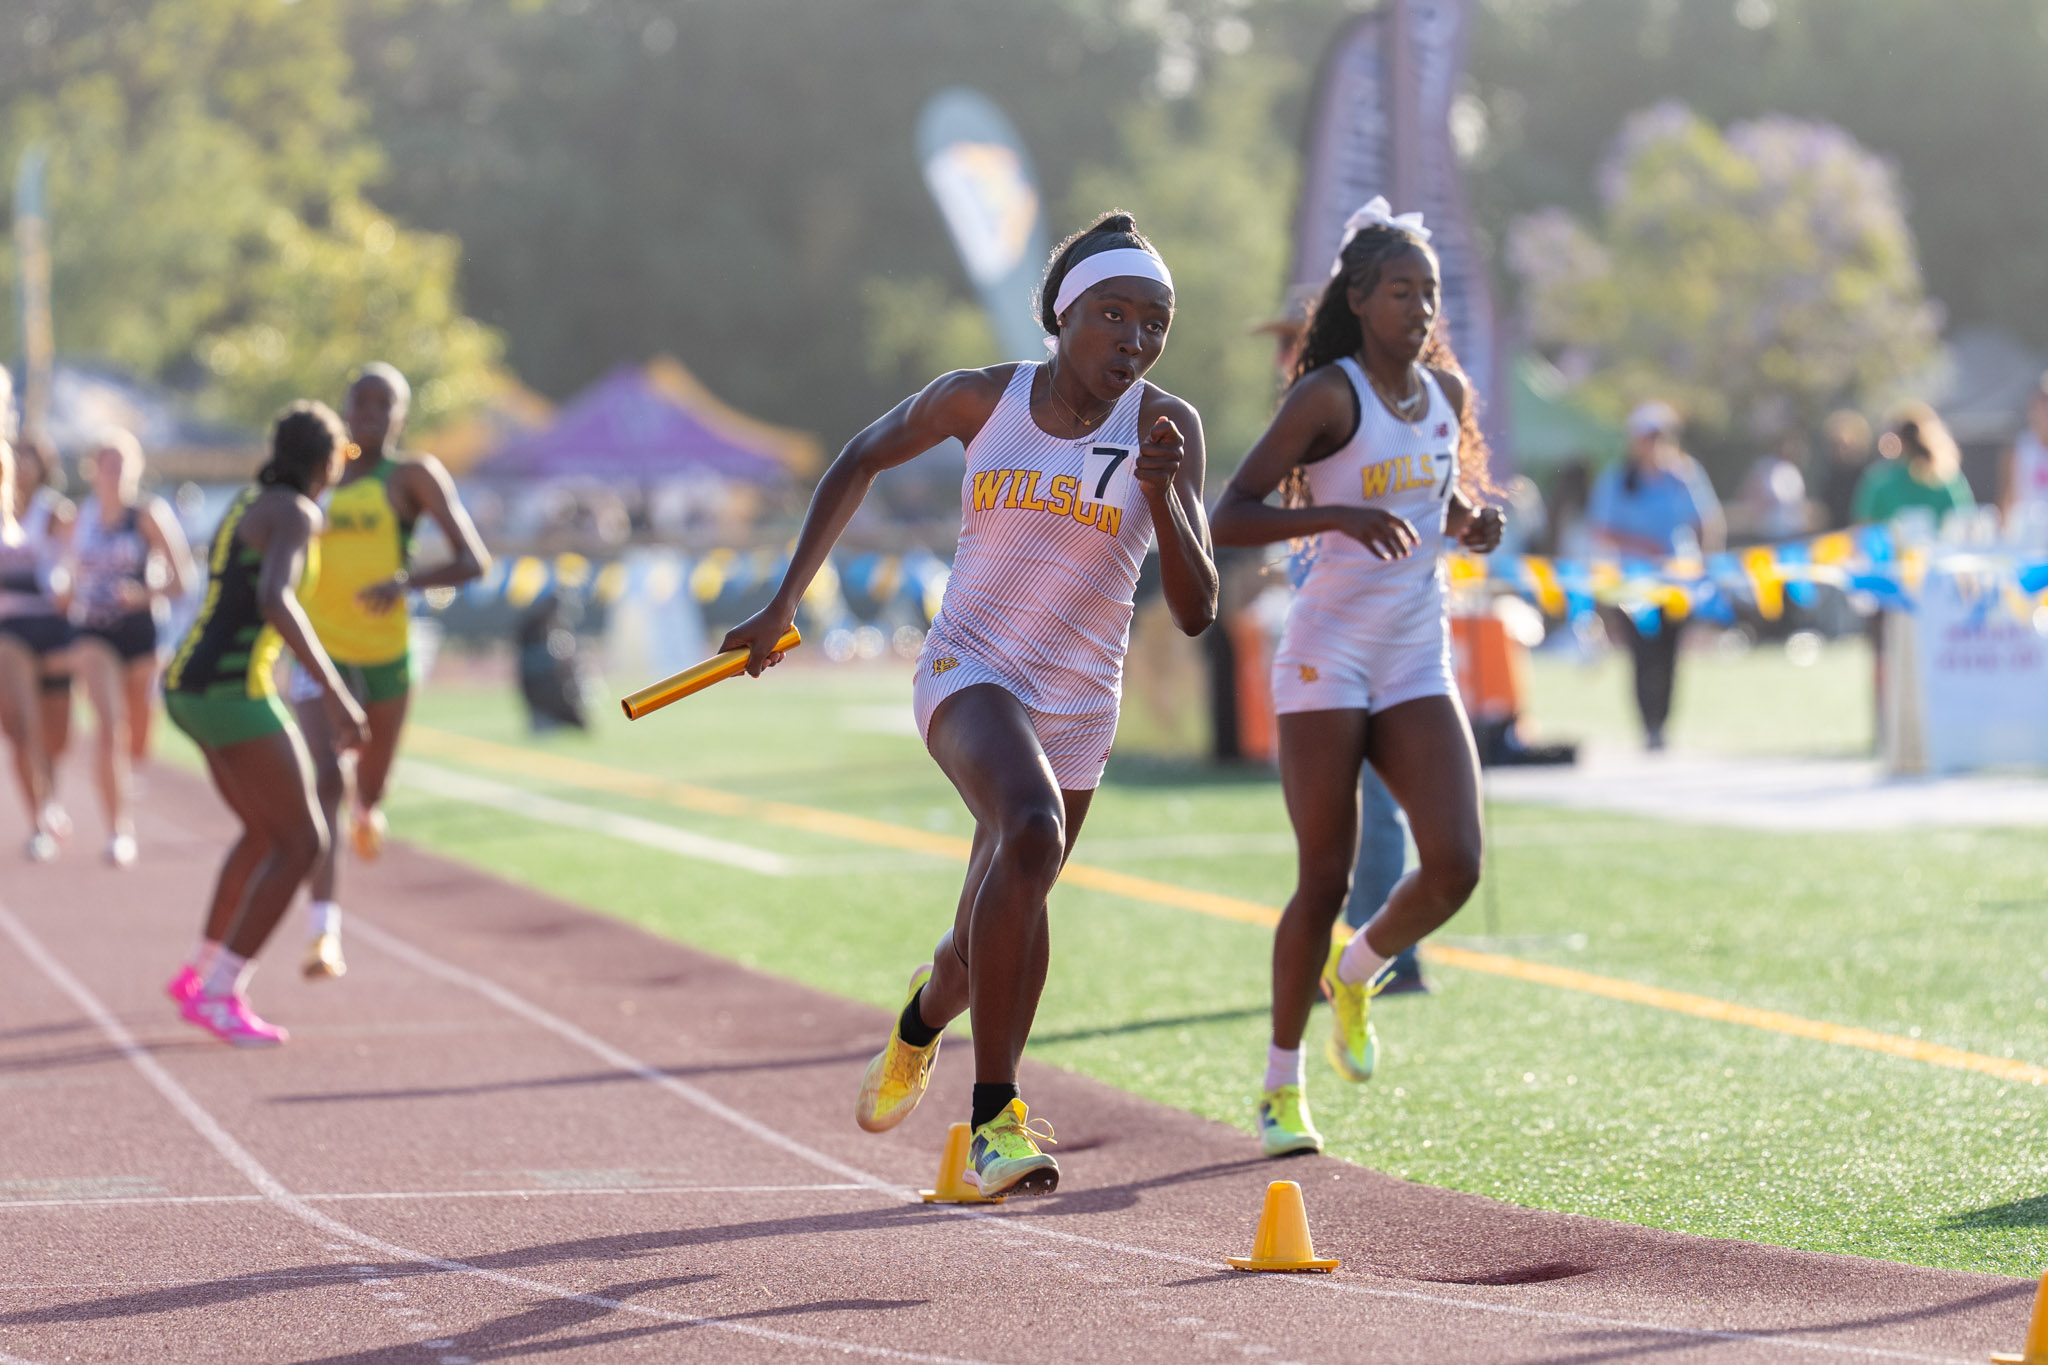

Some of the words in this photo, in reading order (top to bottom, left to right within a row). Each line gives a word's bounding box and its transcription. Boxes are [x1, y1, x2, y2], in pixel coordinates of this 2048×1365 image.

[1092, 447, 1129, 499] 7
[1361, 454, 1435, 499] WILS
[1435, 453, 1453, 498] 7
[973, 469, 1123, 538] WILSON
